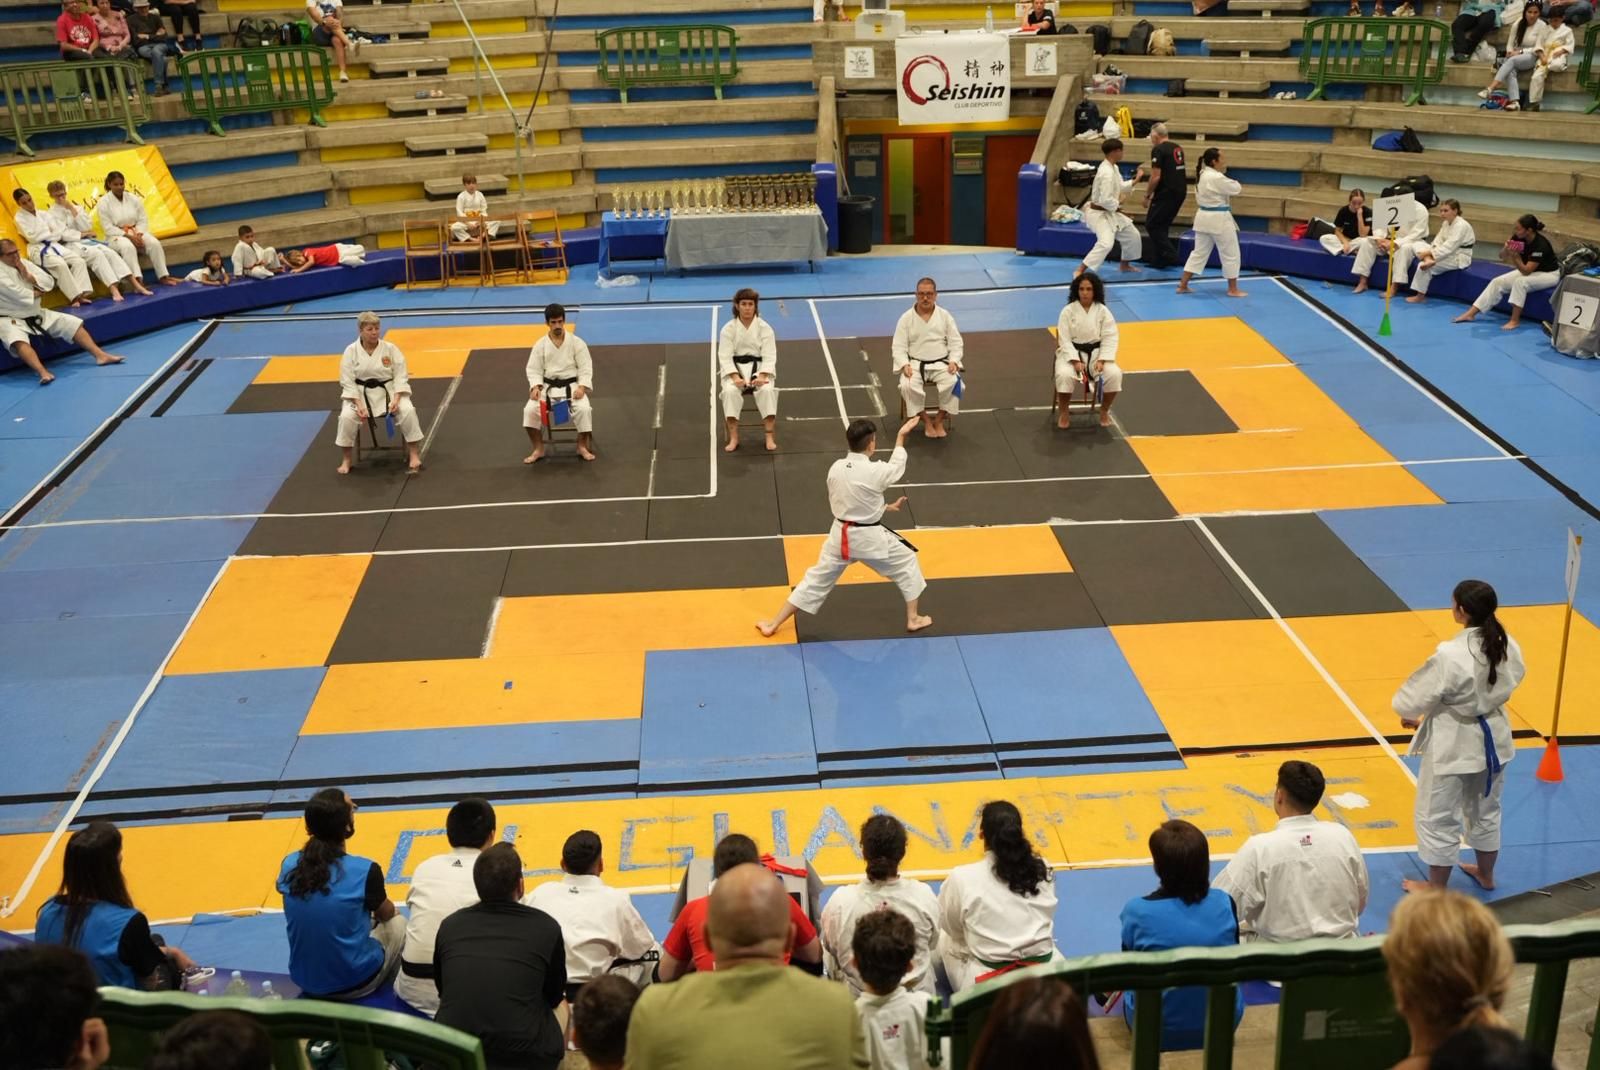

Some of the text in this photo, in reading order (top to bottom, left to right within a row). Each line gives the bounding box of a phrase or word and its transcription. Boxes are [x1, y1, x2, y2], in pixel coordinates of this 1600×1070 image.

[926, 82, 1006, 101] Seishin
[1387, 207, 1400, 225] 2
[1571, 305, 1583, 325] 2
